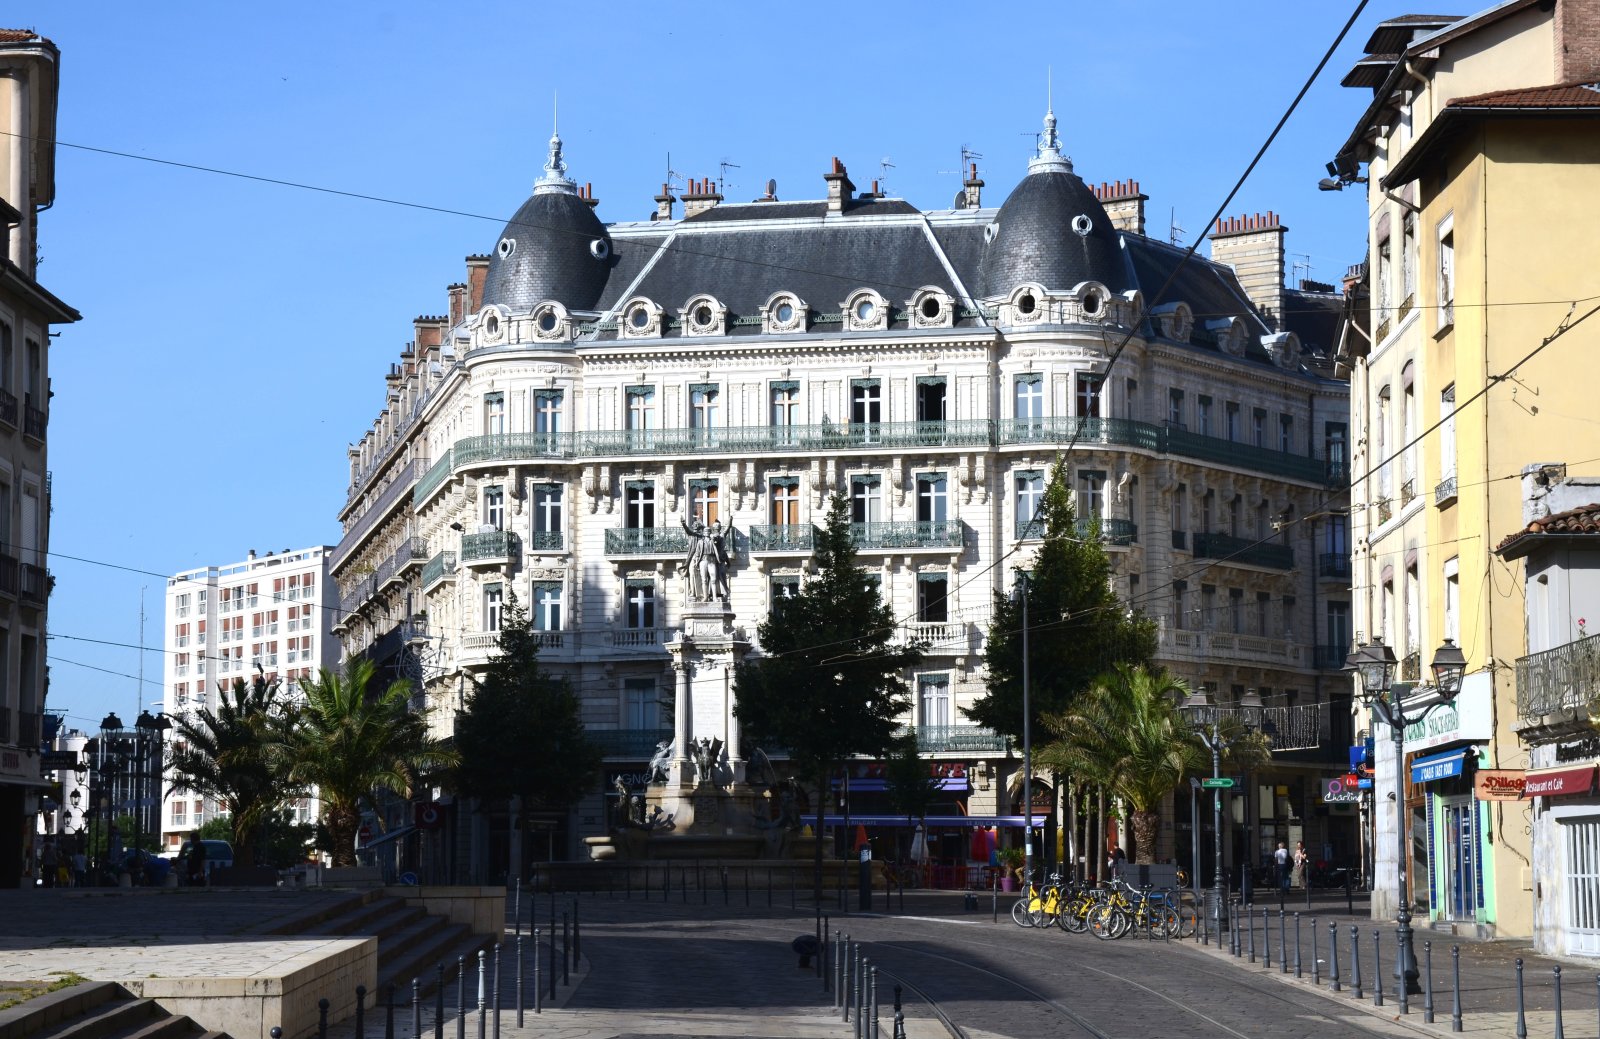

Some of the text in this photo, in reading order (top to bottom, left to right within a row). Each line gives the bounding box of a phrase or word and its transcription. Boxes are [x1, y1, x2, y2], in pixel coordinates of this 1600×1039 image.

[1526, 778, 1563, 793] Restaurant et Café
